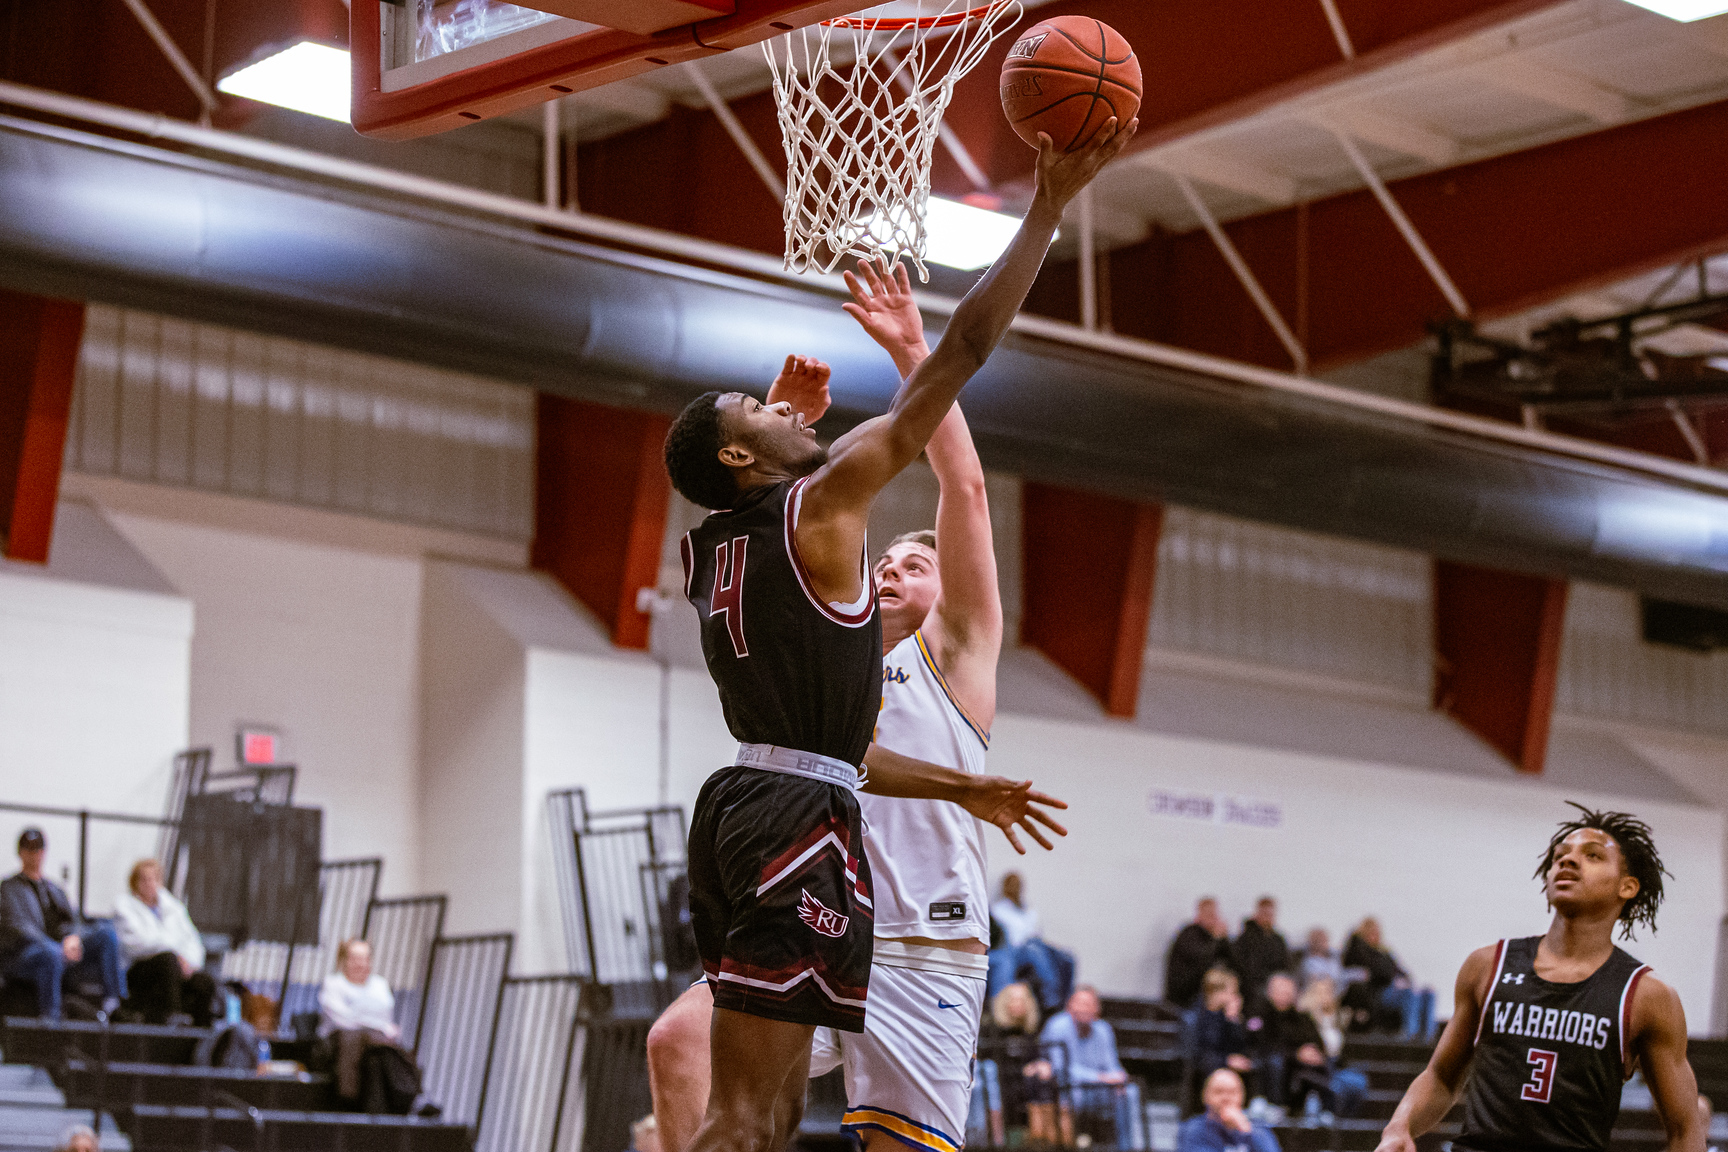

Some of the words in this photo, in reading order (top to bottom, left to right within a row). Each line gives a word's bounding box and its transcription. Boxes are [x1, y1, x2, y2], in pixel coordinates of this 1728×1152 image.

[709, 534, 749, 659] 4
[816, 909, 847, 934] RU
[952, 907, 963, 915] XL
[1493, 1001, 1611, 1050] WARRIORS
[1520, 1047, 1558, 1104] 3
